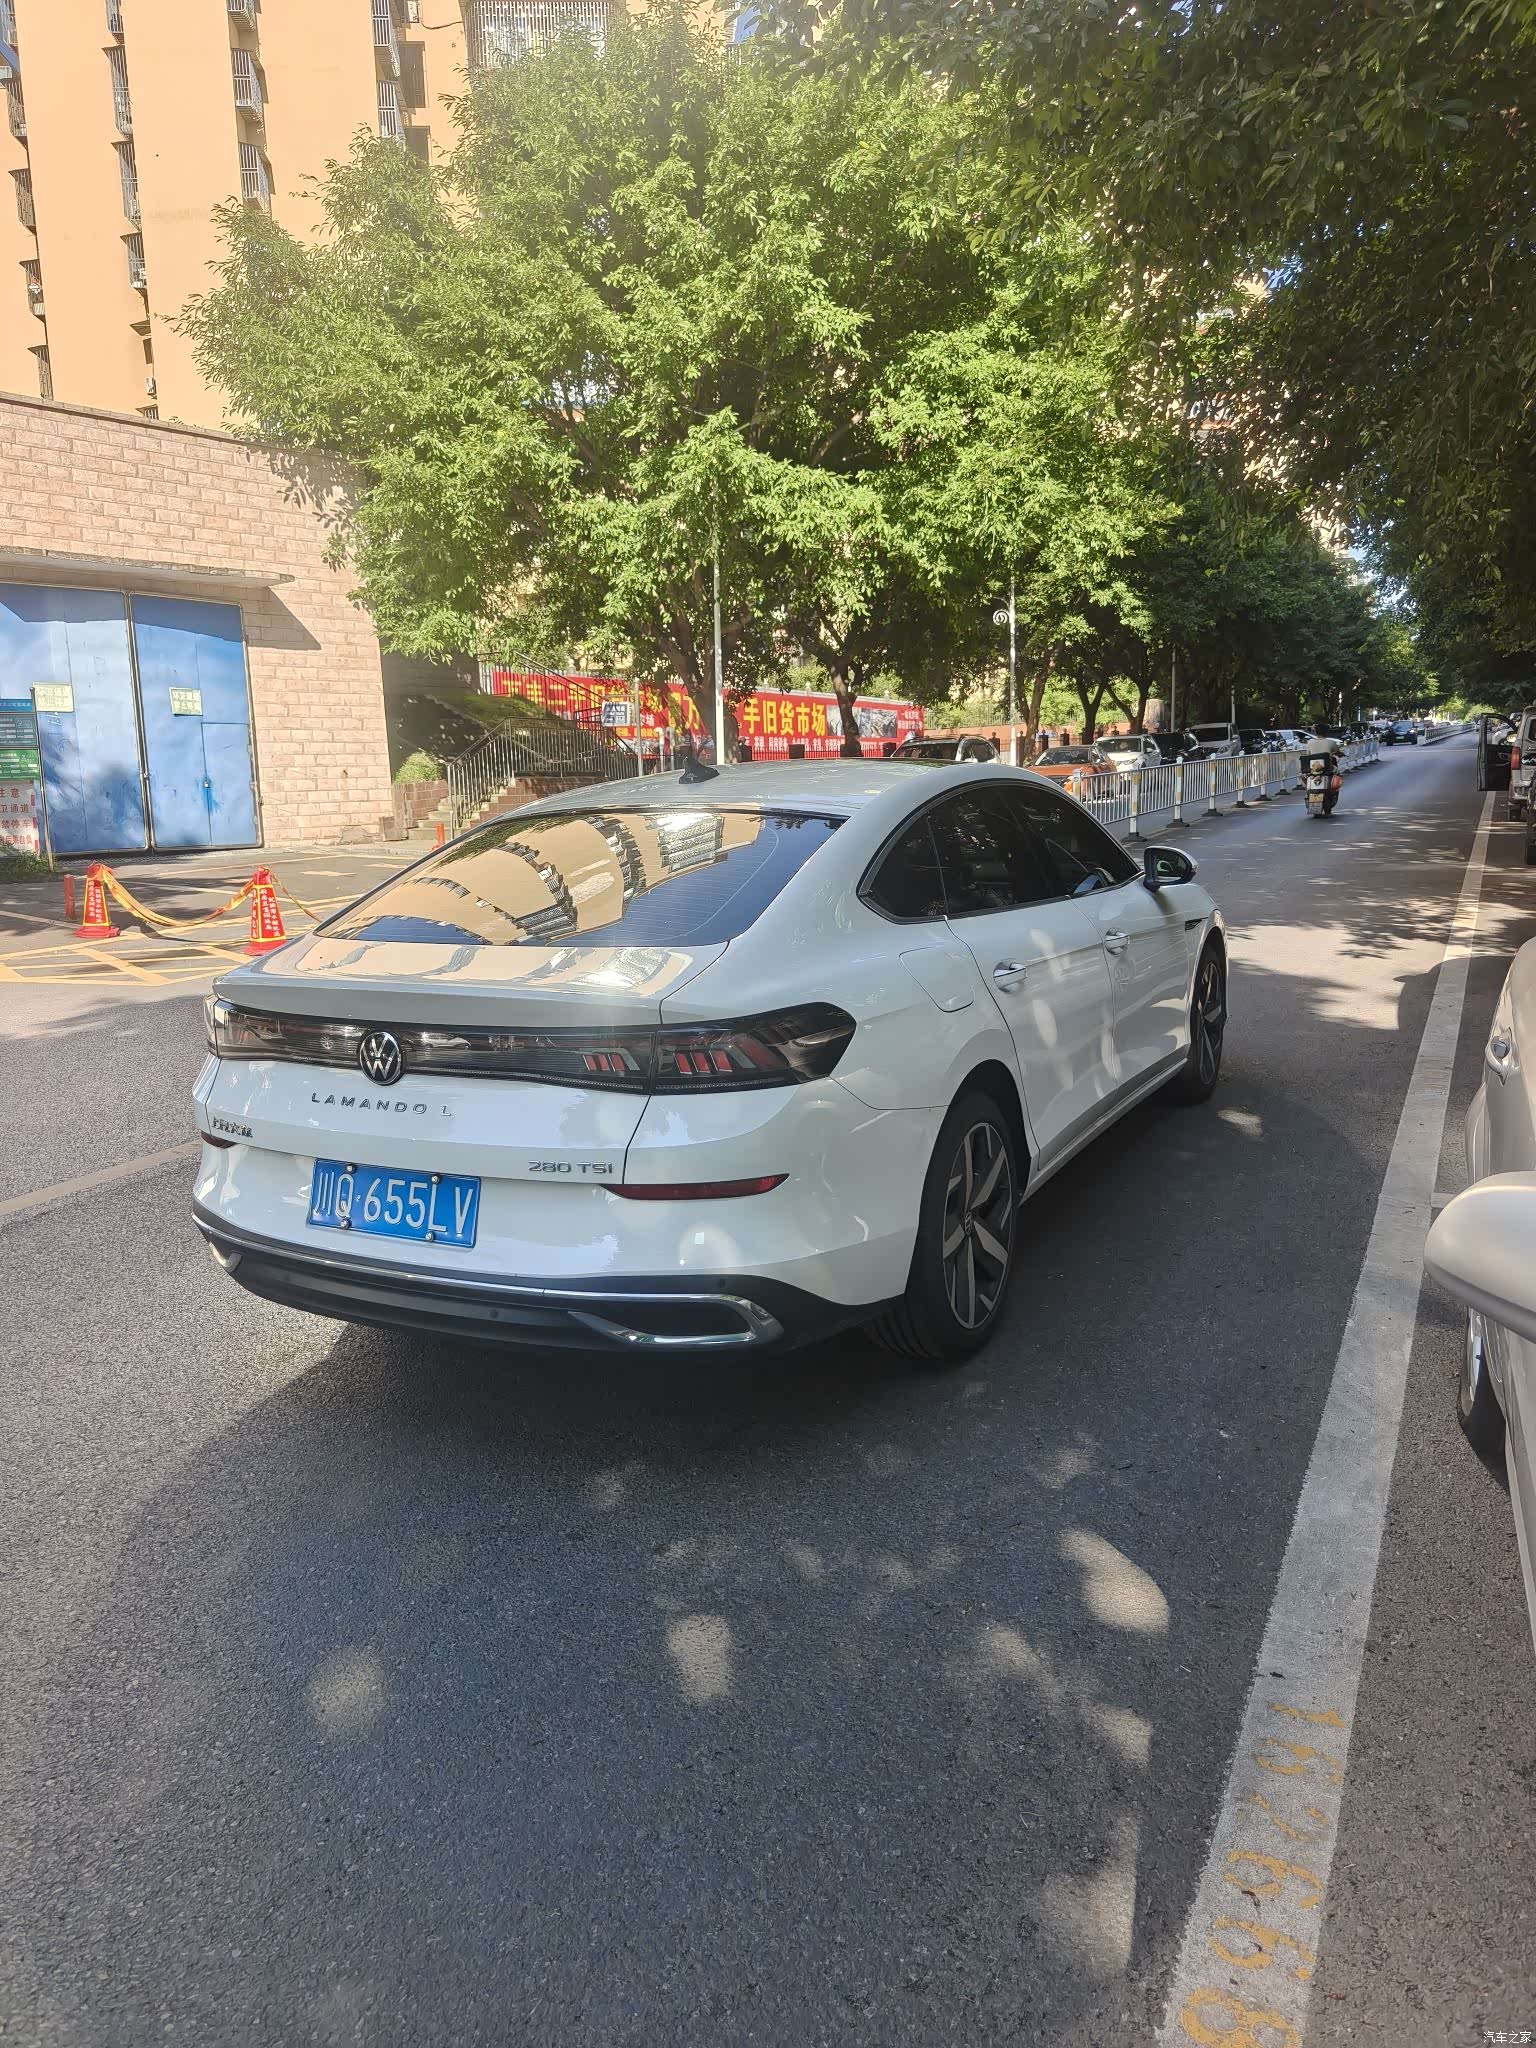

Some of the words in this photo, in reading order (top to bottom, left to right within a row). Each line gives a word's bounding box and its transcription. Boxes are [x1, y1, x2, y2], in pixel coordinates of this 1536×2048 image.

[311, 1092, 428, 1115] LAMANDO
[441, 1105, 452, 1117] L
[528, 1160, 572, 1174] 280
[576, 1161, 613, 1174] TSI
